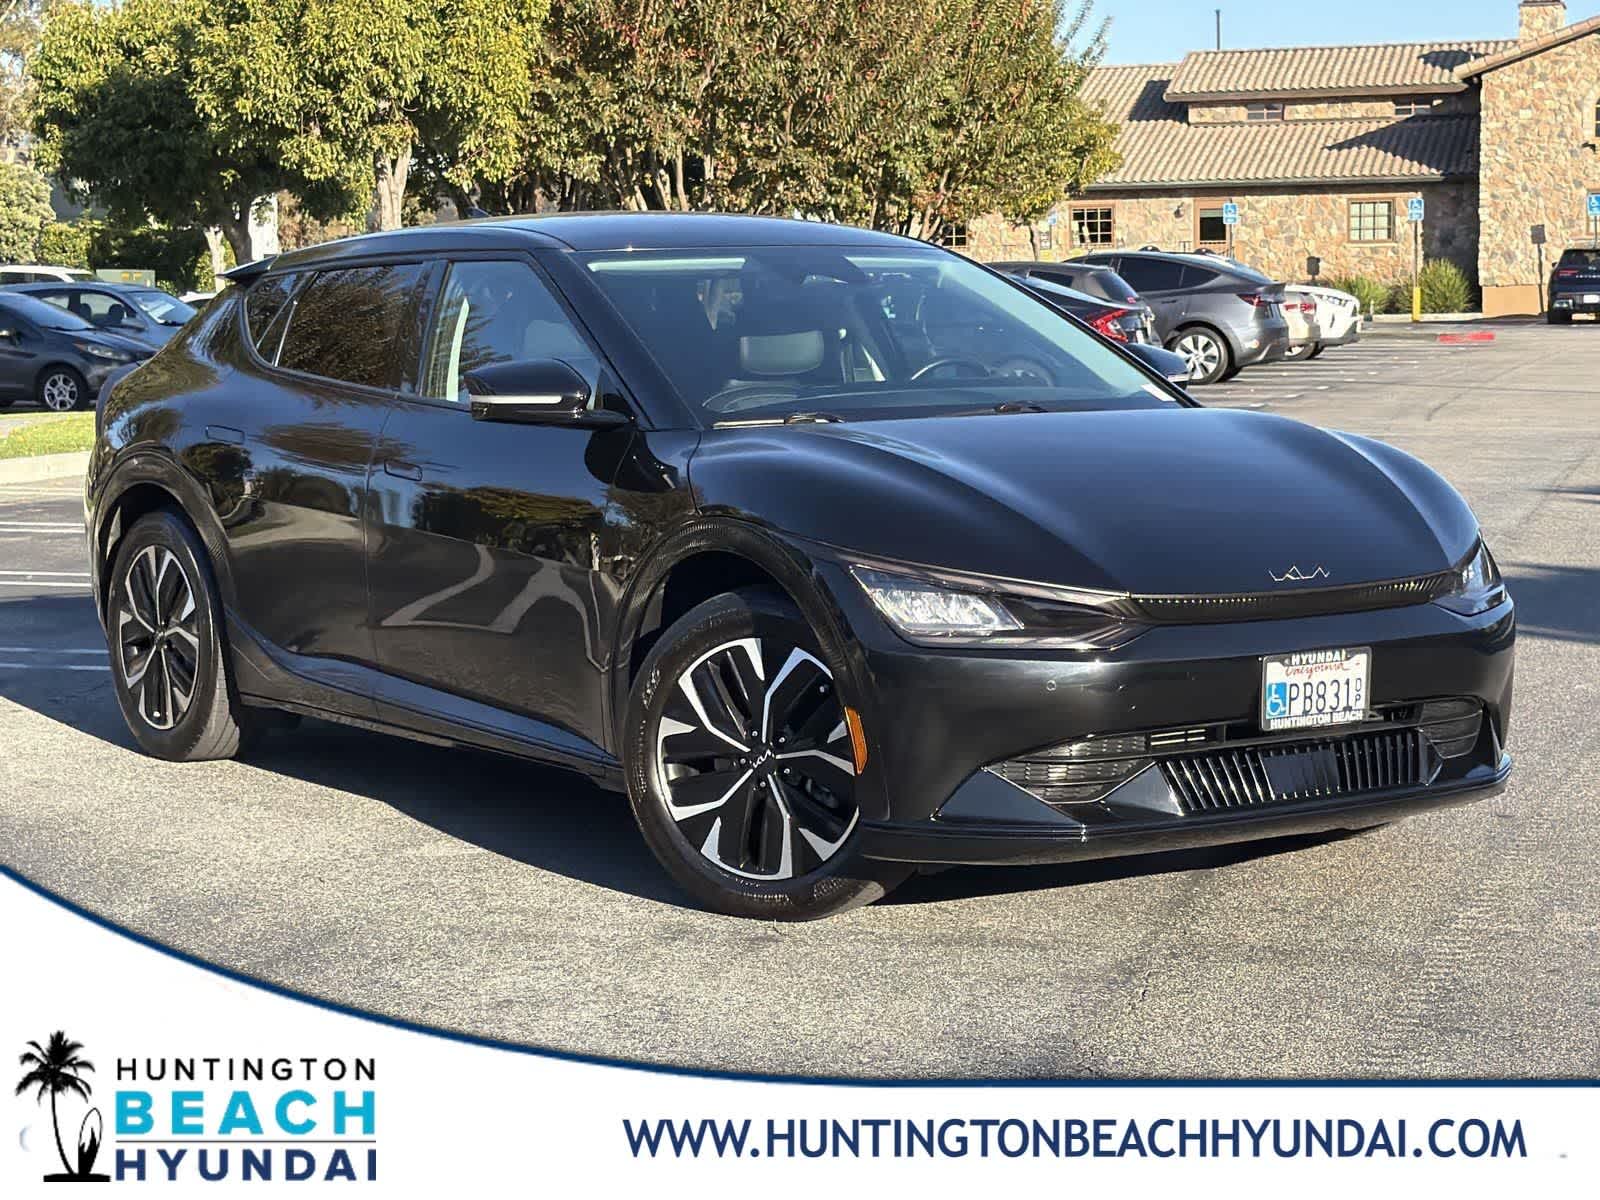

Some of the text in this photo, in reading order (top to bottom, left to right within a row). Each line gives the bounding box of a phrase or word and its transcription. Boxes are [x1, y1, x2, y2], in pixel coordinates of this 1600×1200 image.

[1291, 650, 1346, 666] HYUNDAI
[1289, 678, 1351, 715] PB831
[1270, 710, 1363, 729] HUNTINGTON BEACH
